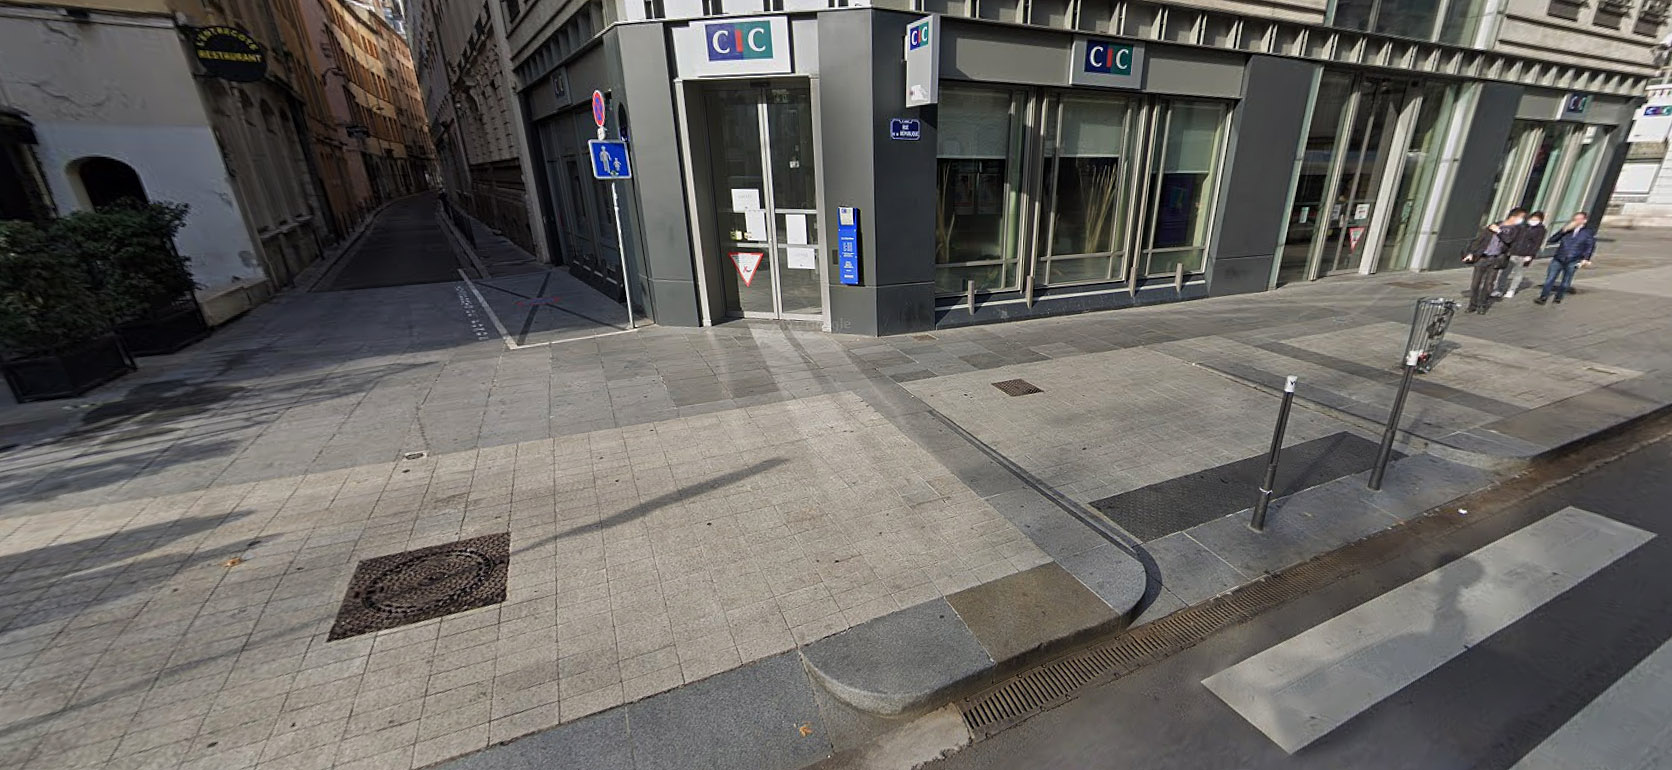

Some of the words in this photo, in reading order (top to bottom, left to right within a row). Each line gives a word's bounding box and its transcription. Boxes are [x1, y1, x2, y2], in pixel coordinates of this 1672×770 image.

[712, 27, 766, 54] CIC
[911, 26, 928, 46] CIC
[197, 49, 262, 62] RESTAURANT
[1090, 45, 1129, 69] CIC
